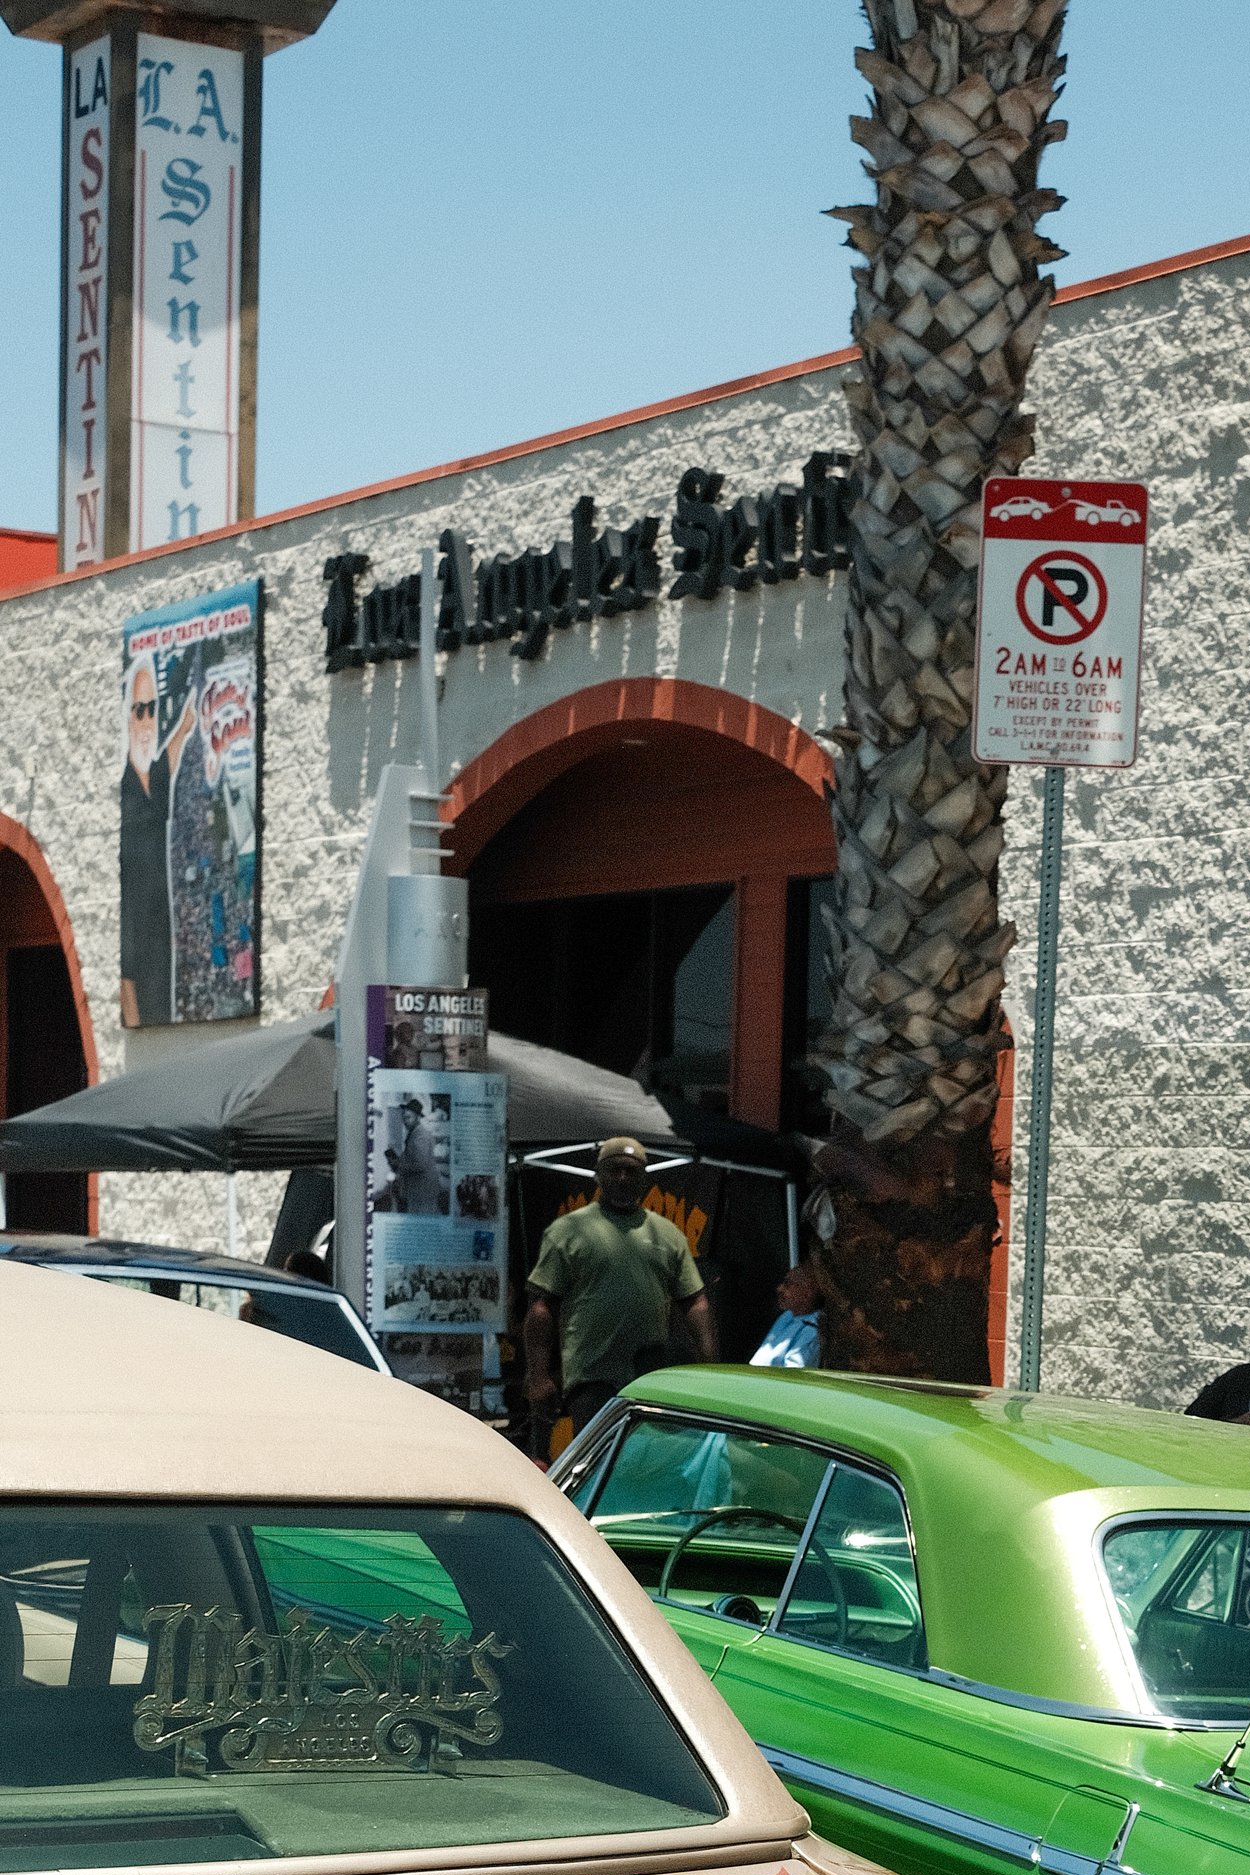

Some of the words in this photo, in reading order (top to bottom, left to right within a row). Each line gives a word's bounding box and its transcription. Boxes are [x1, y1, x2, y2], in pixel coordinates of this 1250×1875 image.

[75, 57, 108, 119] LA
[139, 58, 239, 144] L.A.
[76, 127, 104, 567] SENTIN
[132, 633, 157, 653] HOME
[176, 622, 204, 639] TASTE
[224, 609, 249, 628] SOUL
[996, 647, 1046, 676] 2AM
[1072, 651, 1122, 679] 6AM
[1009, 680, 1068, 696] VEHICLES
[1075, 682, 1107, 697] OVER
[1007, 697, 1037, 710] HIGH
[1043, 698, 1060, 711] OR
[1089, 701, 1121, 714] LONG
[1013, 715, 1047, 726] EXCEPT
[1051, 717, 1062, 727] BY
[1067, 718, 1099, 728] PERMIT
[989, 726, 1007, 737] CALL
[1040, 729, 1057, 739] FOR
[1061, 730, 1123, 741] INFORMATION
[395, 993, 425, 1012] LOS
[321, 1713, 360, 1728] LOS
[282, 1736, 371, 1751] ANGELES
